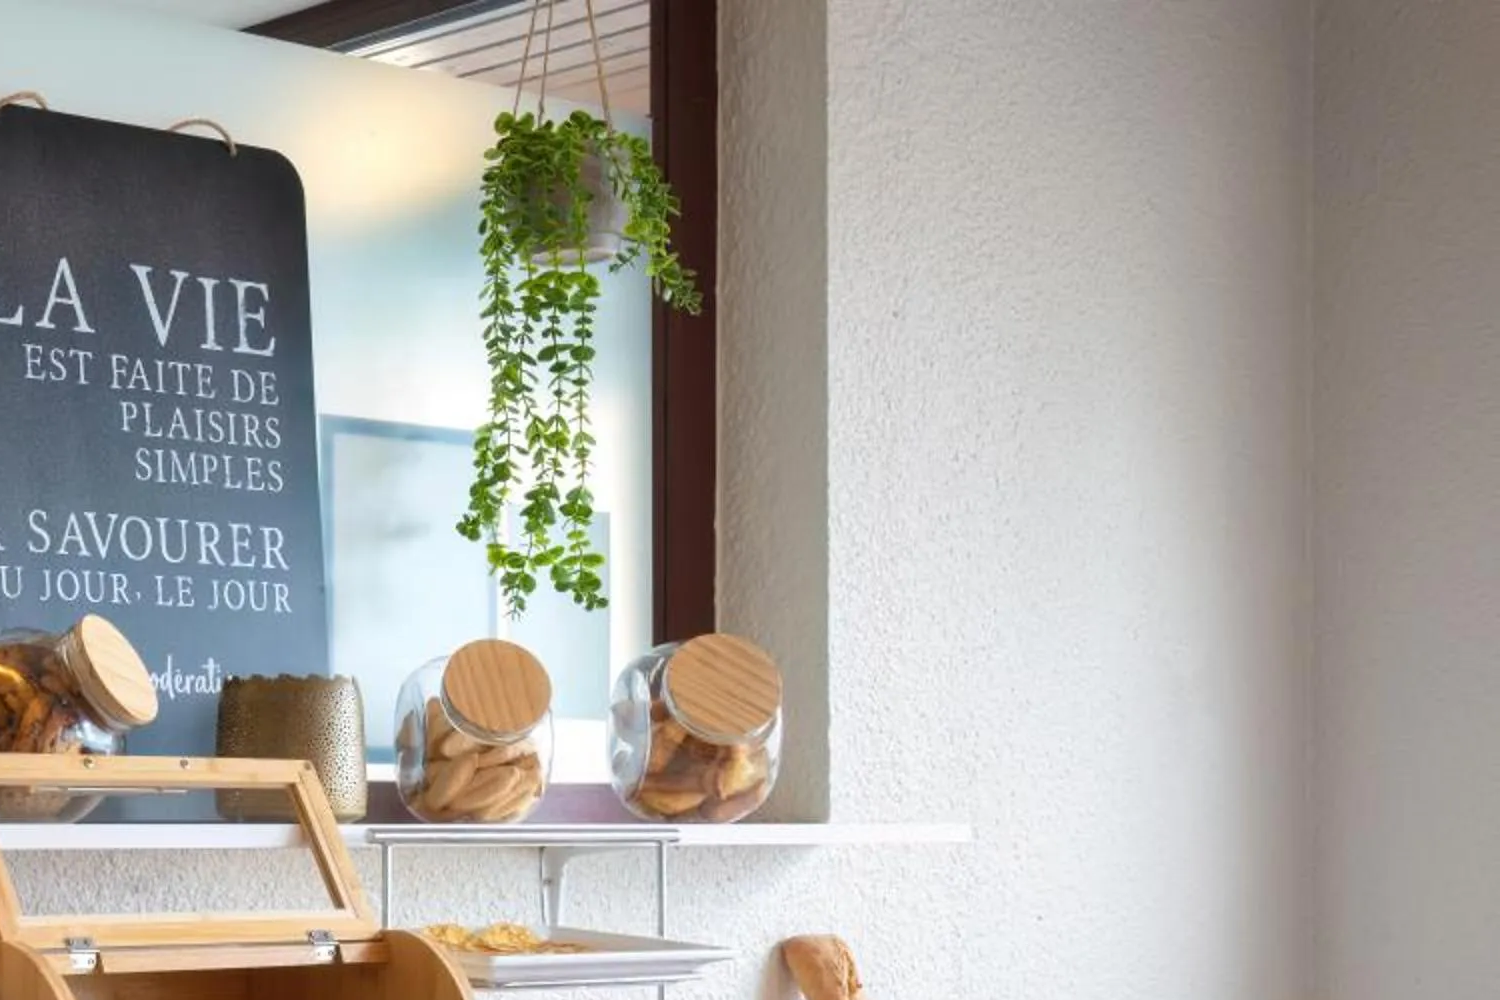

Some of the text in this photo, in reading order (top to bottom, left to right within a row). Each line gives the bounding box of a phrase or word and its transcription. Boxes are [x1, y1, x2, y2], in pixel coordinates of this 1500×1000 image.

[129, 263, 276, 357] VIE
[22, 343, 279, 405] EST FAITE DE
[120, 401, 282, 449] PLAISIRS
[135, 448, 284, 493] SIMPLES
[27, 508, 290, 571] SAVOURER
[155, 575, 195, 608] LE
[207, 580, 293, 614] JOUR
[149, 653, 223, 700] odérati
